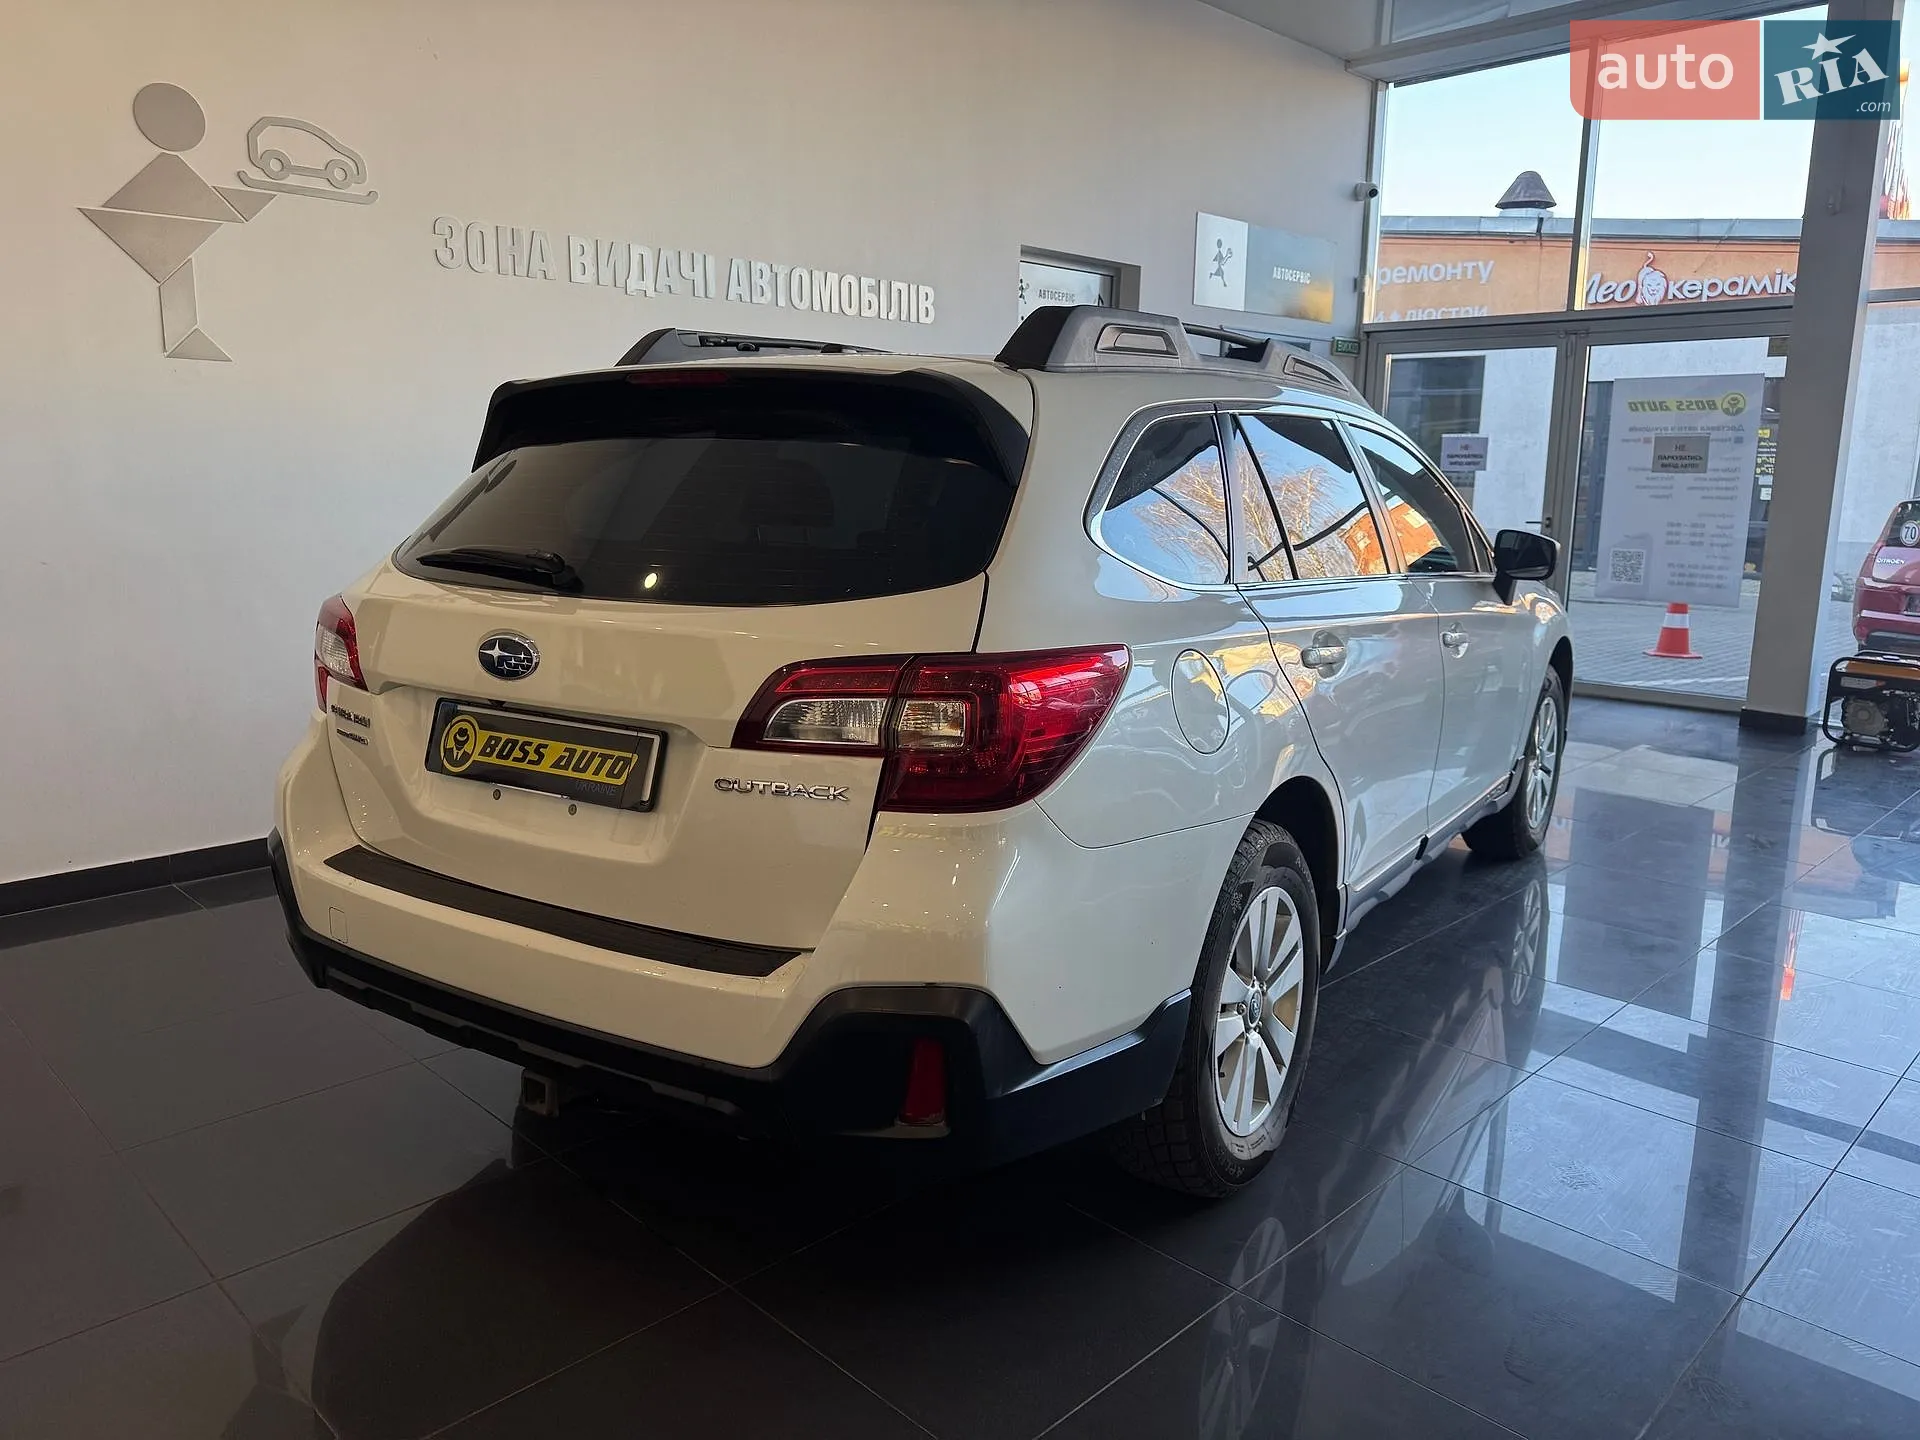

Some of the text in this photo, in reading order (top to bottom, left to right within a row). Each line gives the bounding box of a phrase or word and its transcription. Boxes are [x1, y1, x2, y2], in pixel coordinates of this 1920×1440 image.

[432, 216, 936, 325] ЗОНА ВИДАЧІ АВТОМОБІЛІВ
[1376, 260, 1495, 290] ремонту
[1903, 525, 1917, 541] 70
[478, 735, 633, 780] BOSS AUTO
[714, 778, 849, 801] OUTBACK
